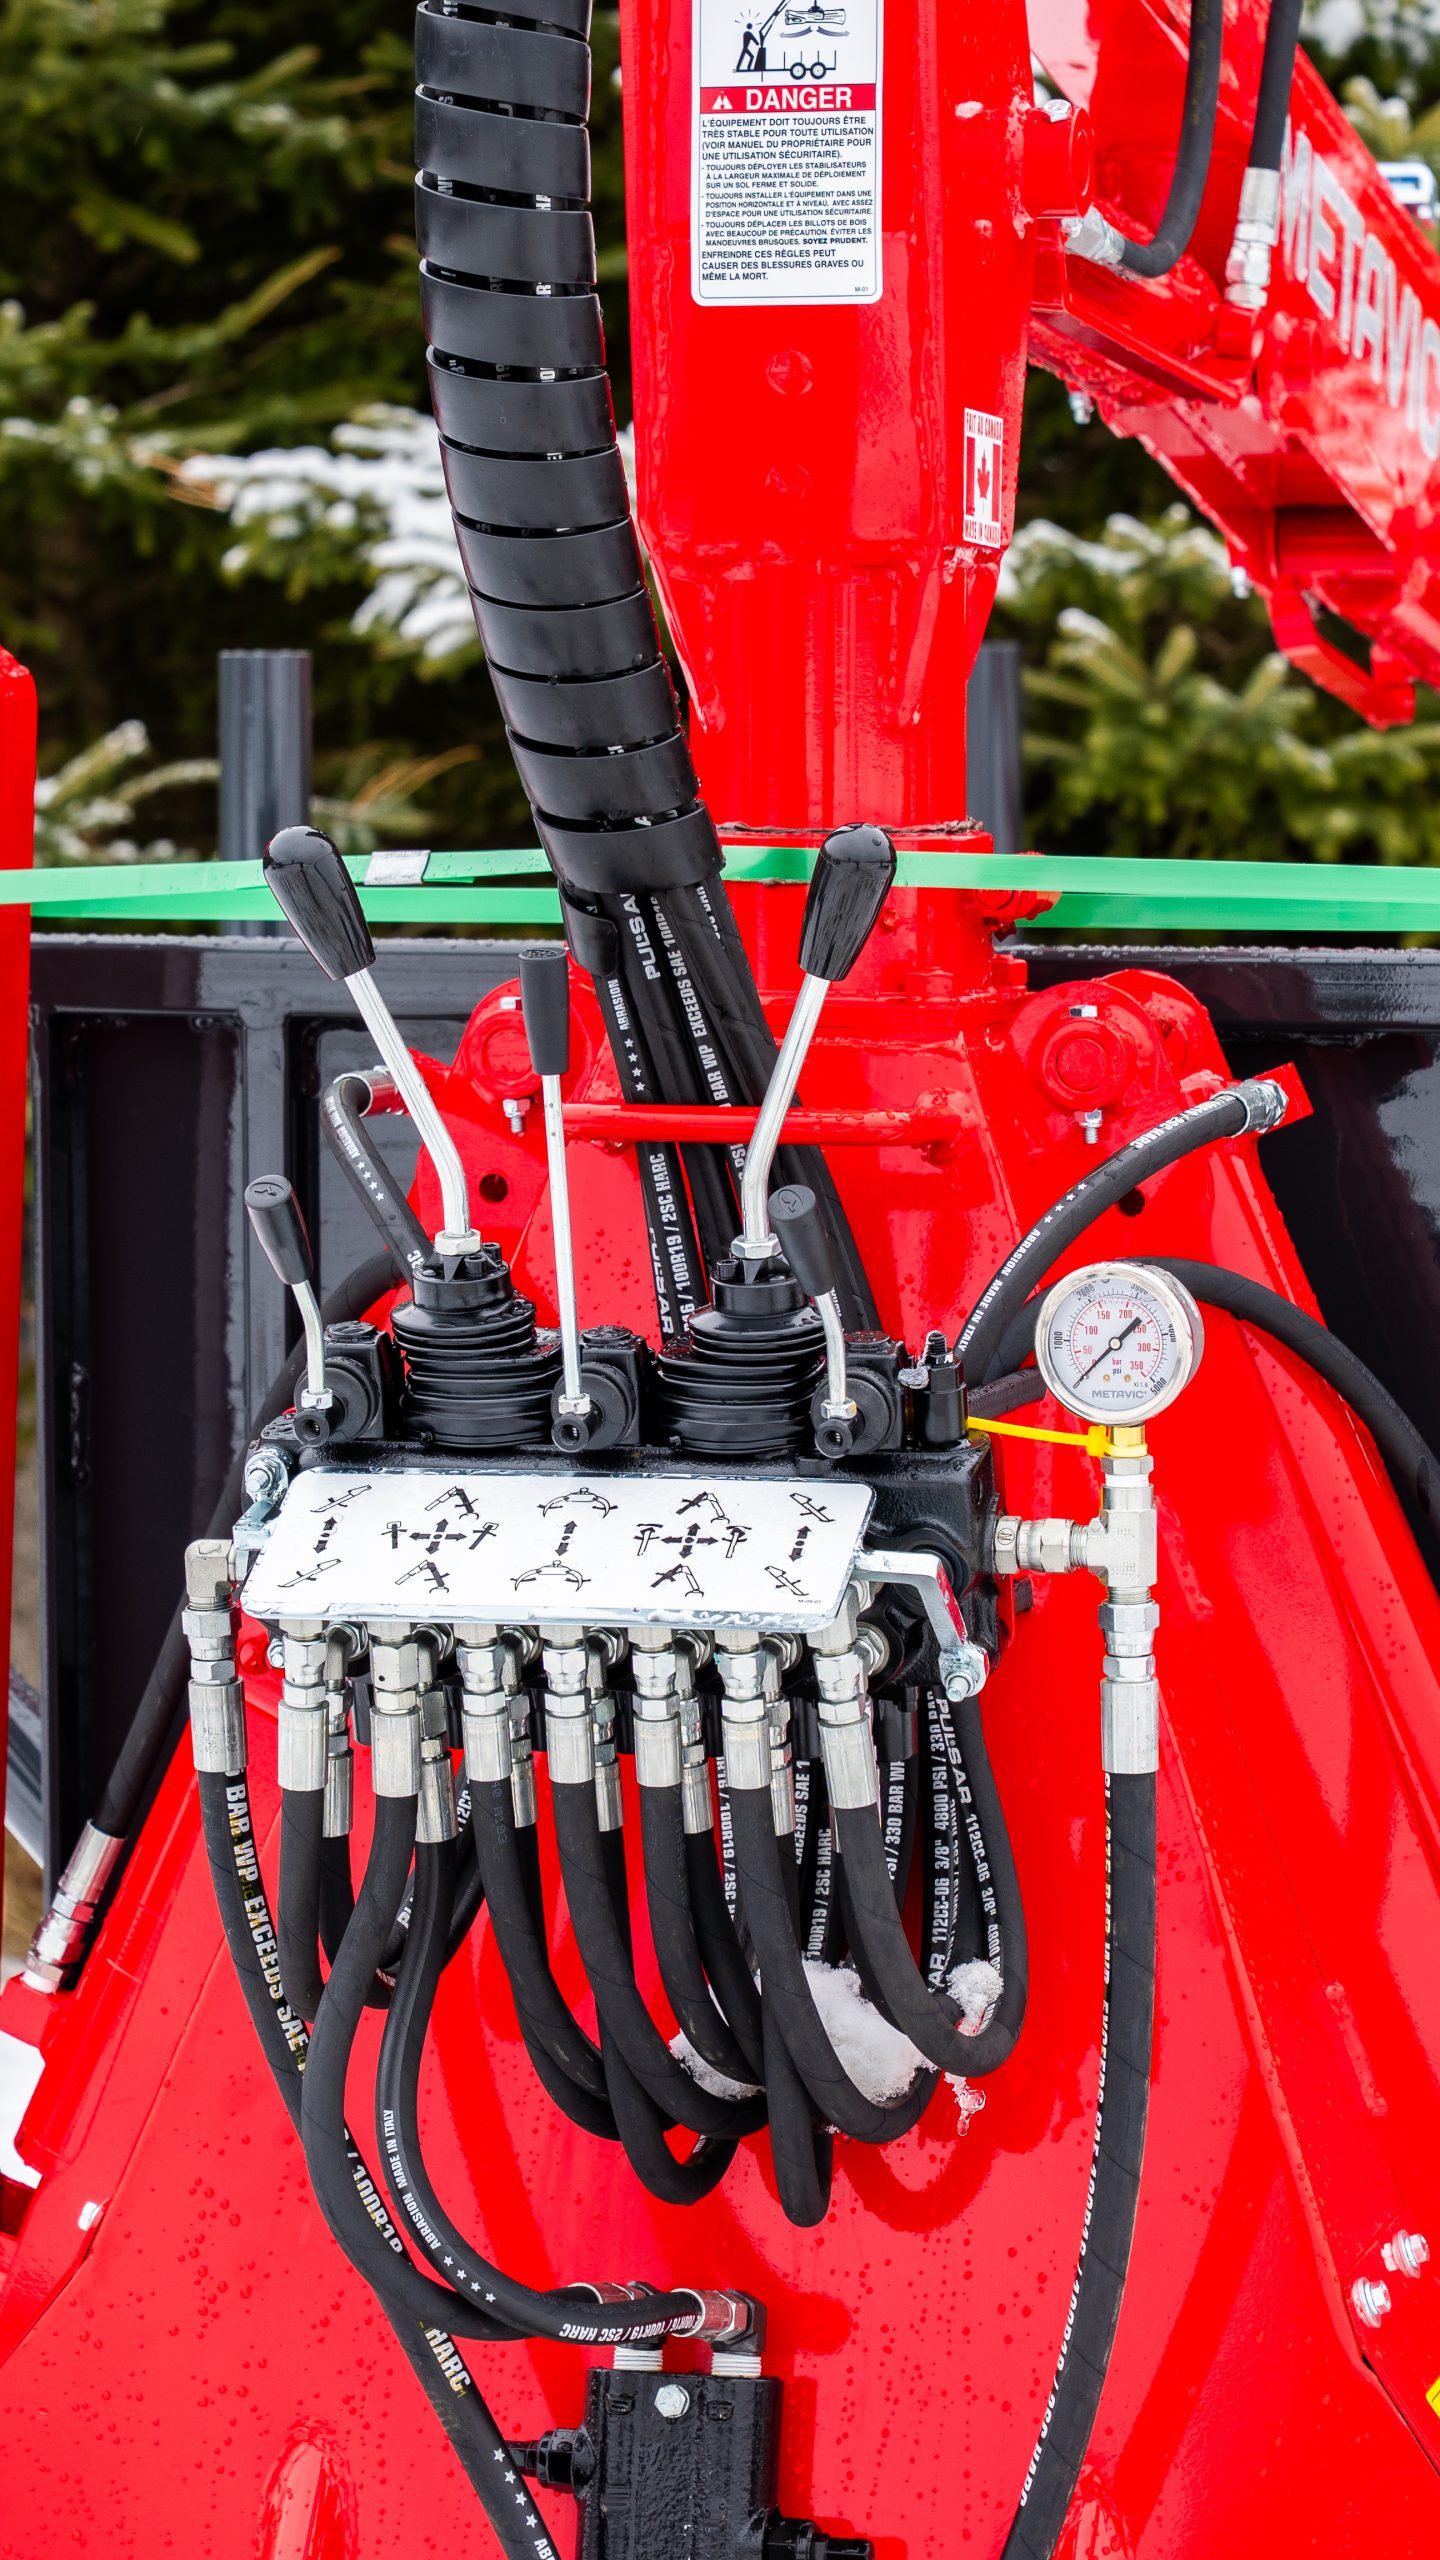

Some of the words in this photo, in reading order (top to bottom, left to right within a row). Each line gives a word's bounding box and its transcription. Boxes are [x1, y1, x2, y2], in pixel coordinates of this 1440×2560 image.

[746, 87, 852, 110] DANGER
[702, 117, 767, 127] L'ÉQUIPEMENT
[769, 118, 790, 126] DOIT
[793, 117, 840, 125] TOUJOURS
[843, 115, 866, 125] ÊTRE
[702, 129, 725, 138] TRÈS
[727, 130, 760, 138] STABLE
[763, 129, 787, 137] POUR
[790, 129, 818, 137] TOUTE
[821, 128, 874, 136] UTILISATION
[702, 141, 725, 149] (VOIR
[728, 141, 764, 149] MANUEL
[766, 140, 779, 148] DU
[781, 138, 844, 148] PROPRIÉTAIRE
[847, 139, 872, 147] POUR
[702, 152, 720, 160] UNE
[723, 151, 776, 160] UTILISATION
[779, 149, 842, 159] SÉCURITAIRE).
[706, 172, 711, 180] À
[814, 169, 866, 178] DÉPLOIEMENT
[748, 162, 787, 170] DÉPLOYER
[784, 190, 834, 198] L'ÉQUIPEMENT
[796, 199, 801, 207] À
[747, 219, 786, 227] DÉPLACER
[825, 207, 872, 215] SÉCURITAIRE.
[780, 227, 828, 236] PRÉCAUTION.
[830, 227, 856, 235] ÉVITER
[702, 251, 752, 259] ENFREINDRE
[754, 250, 772, 258] CES
[775, 248, 811, 257] RÈGLES
[813, 249, 836, 257] PEUT
[702, 262, 738, 270] CAUSER
[741, 261, 759, 269] DES
[761, 261, 812, 269] BLESSURES
[814, 260, 849, 268] GRAVES
[702, 272, 727, 281] MÊME
[742, 272, 768, 280] MORT.
[1280, 113, 1440, 462] METAVIC
[966, 412, 976, 434] FAIT
[984, 416, 1002, 440] CANADA
[965, 519, 976, 540] MADE
[978, 522, 982, 542] IN
[984, 524, 1000, 544] CANADA
[668, 950, 688, 977] SAE
[608, 979, 630, 1031] ABRASION
[678, 980, 708, 1038] EXCEEDS
[707, 1070, 729, 1101] BAR
[1130, 1127, 1165, 1148] HARC
[650, 1152, 670, 1192] HARC
[658, 1194, 678, 1223] 2SC
[666, 1234, 690, 1290] 100R19
[1001, 1229, 1041, 1276] ABRASION
[980, 1279, 1004, 1309] MADE
[1077, 1284, 1095, 1298] 2000
[971, 1310, 984, 1324] IN
[1097, 1310, 1110, 1320] 150
[1119, 1310, 1132, 1318] 200
[958, 1324, 976, 1352] ITALY
[1054, 1331, 1063, 1350] 1000
[1085, 1326, 1098, 1335] 100
[1133, 1324, 1146, 1334] 250
[1084, 1346, 1092, 1354] 50
[1138, 1343, 1152, 1352] 300
[1112, 1368, 1122, 1376] psi
[1130, 1360, 1144, 1370] 350
[1150, 1377, 1167, 1396] 5000
[930, 1724, 946, 1752] 330
[795, 1774, 810, 1800] SAE
[932, 1766, 948, 1790] PSI
[226, 1783, 250, 1834] BAR
[888, 1785, 904, 1814] BAR
[934, 1794, 950, 1831] 4800
[720, 1803, 735, 1859] 100R19
[885, 1817, 902, 1845] 330
[817, 1828, 832, 1866] HARC
[935, 1840, 950, 1870] 3/8"
[966, 1814, 990, 1882] 112CC-06
[234, 1840, 258, 1883] WP
[724, 1872, 736, 1900] 2SC
[815, 1869, 832, 1896] 2SC
[932, 1878, 950, 1944] 112CC-06
[982, 1888, 996, 1916] 3/8"
[806, 1908, 828, 1958] 100R19
[988, 1924, 1000, 1958] 4800
[244, 1895, 284, 2000] EXCEEDS
[276, 2004, 309, 2052] SAE
[383, 2109, 394, 2138] ITALY
[387, 2133, 396, 2152] IN
[390, 2153, 408, 2189] MADE
[402, 2194, 441, 2250] ABRASION
[559, 2323, 597, 2340] HARC
[598, 2331, 624, 2342] 2SC
[630, 2320, 666, 2340] 100R19
[426, 2328, 472, 2392] HARC
